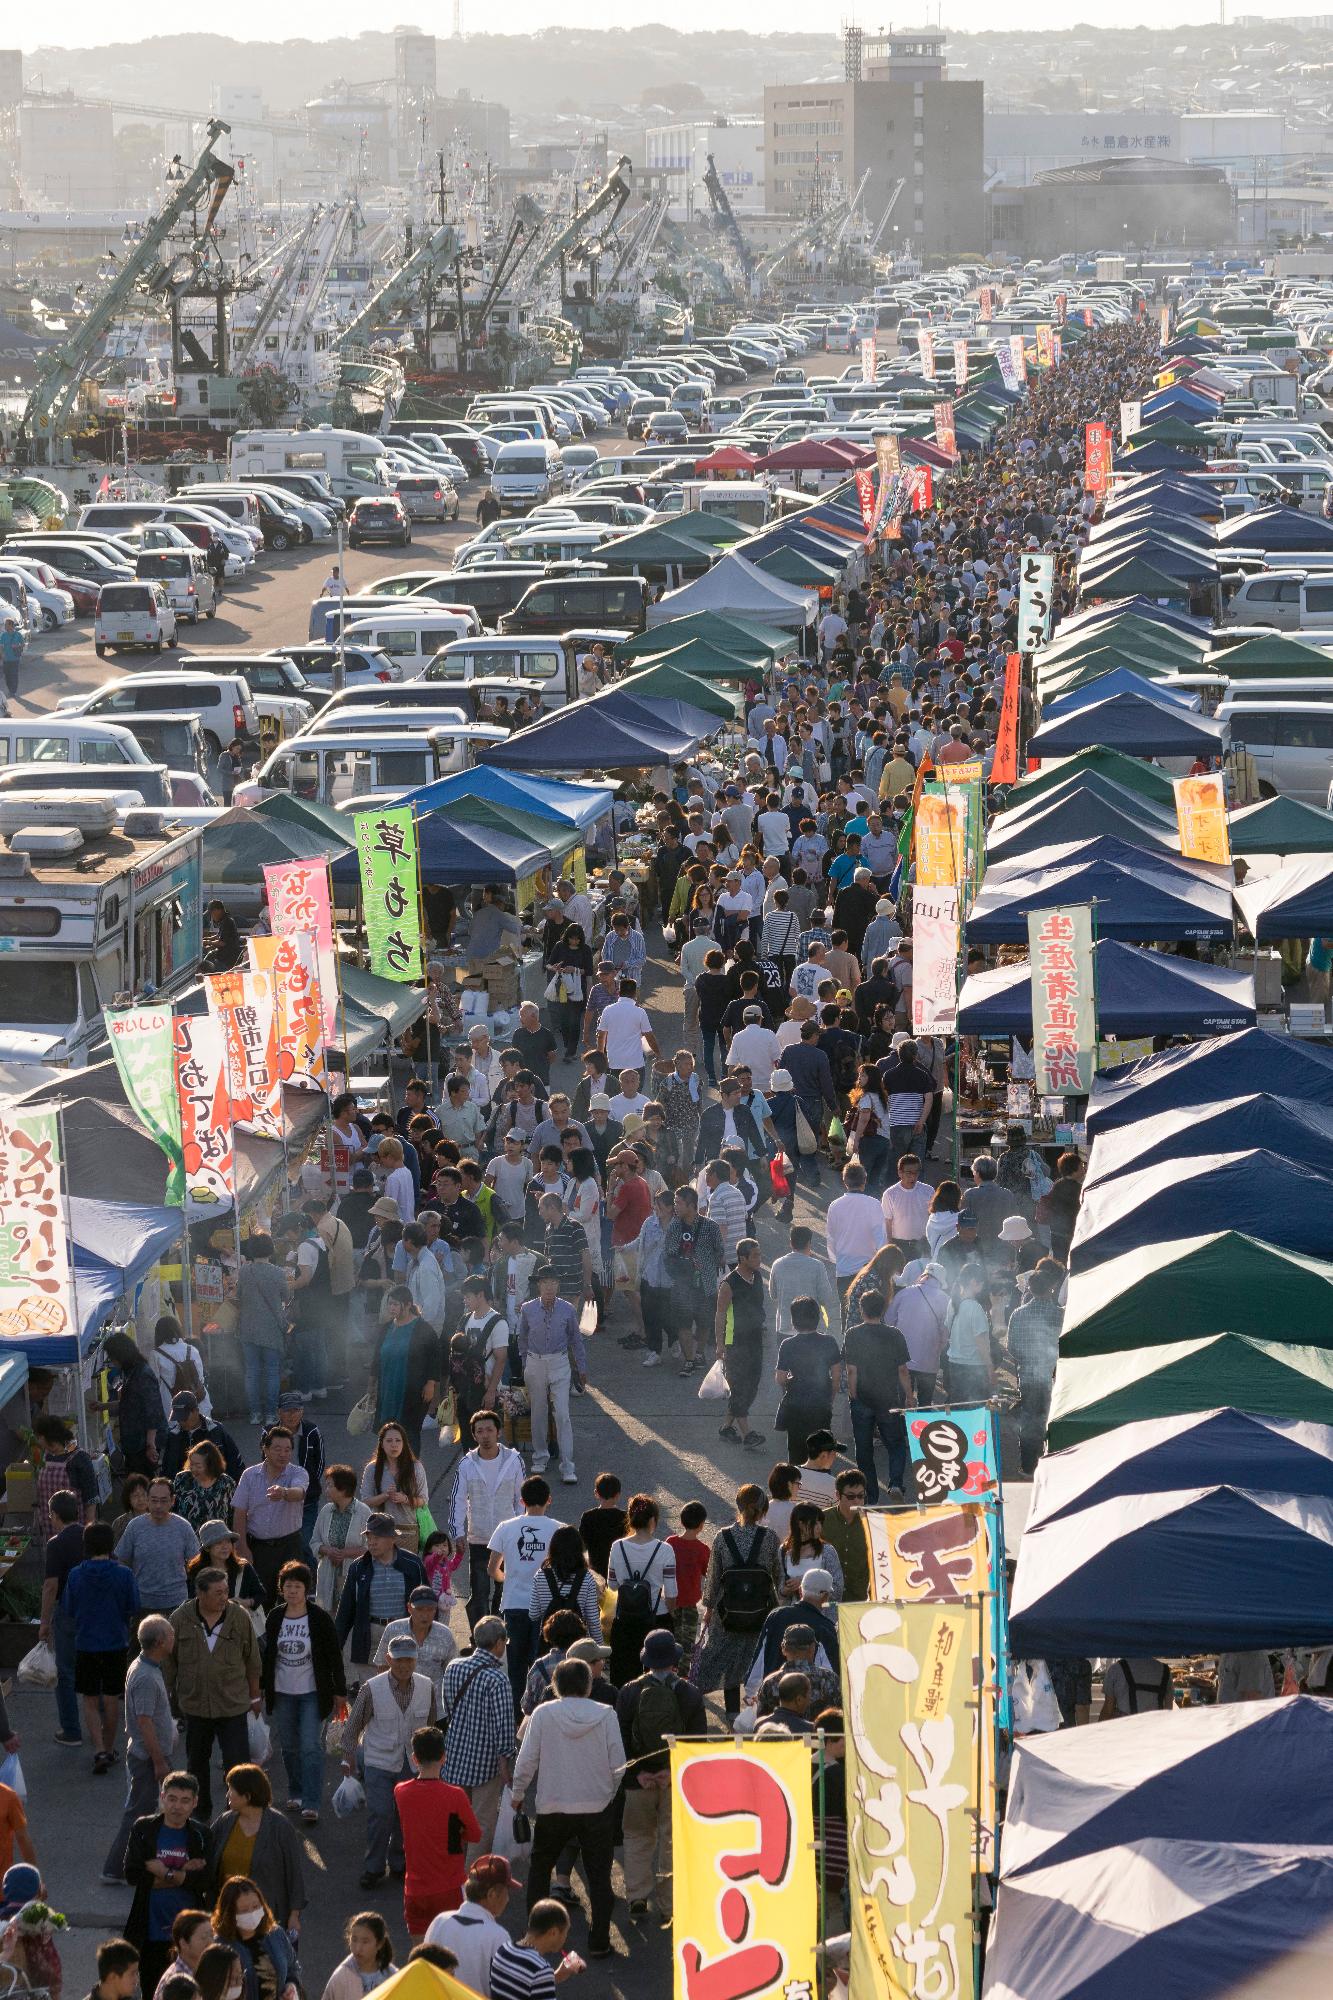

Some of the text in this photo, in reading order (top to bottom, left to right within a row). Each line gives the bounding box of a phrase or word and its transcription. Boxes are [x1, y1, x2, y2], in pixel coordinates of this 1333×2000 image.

[1023, 558, 1048, 648] とうふ
[763, 969, 782, 988] 23
[112, 1015, 165, 1034] おいしい
[915, 1424, 961, 1500] うまい!
[526, 1542, 544, 1551] CHUMS
